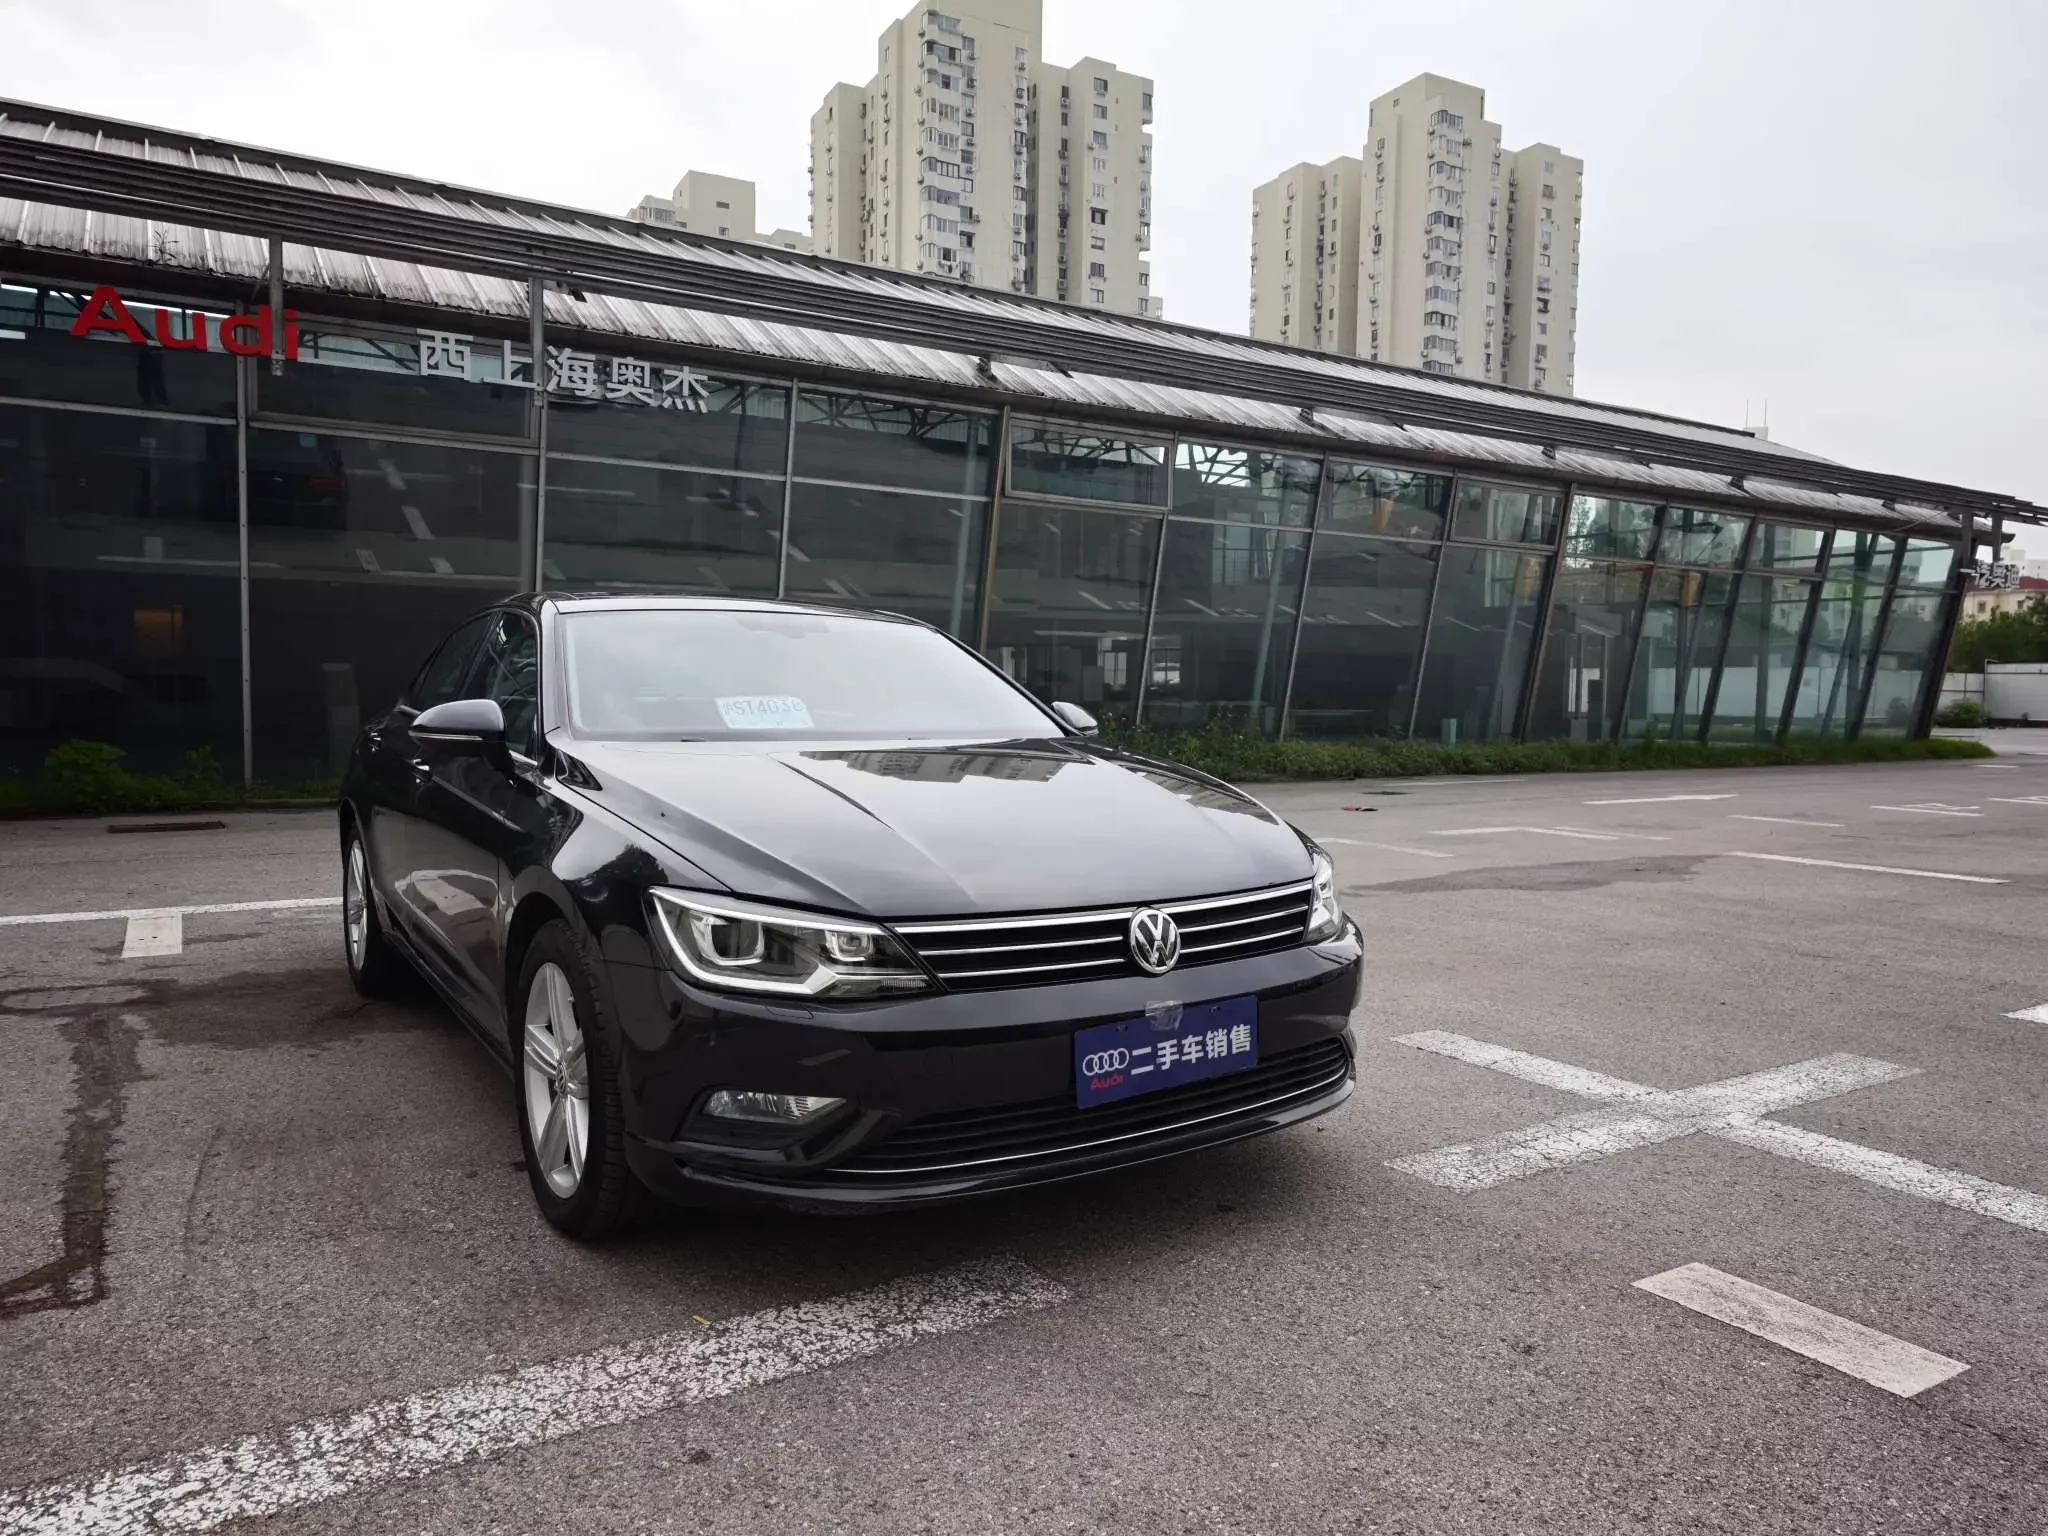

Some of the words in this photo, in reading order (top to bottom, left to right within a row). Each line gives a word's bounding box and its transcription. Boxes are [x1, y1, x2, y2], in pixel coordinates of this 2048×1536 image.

[68, 284, 299, 361] Audi
[416, 328, 710, 414] 西上海奥杰
[1091, 1074, 1124, 1090] Audi
[1130, 1024, 1251, 1076] 二手车销售
